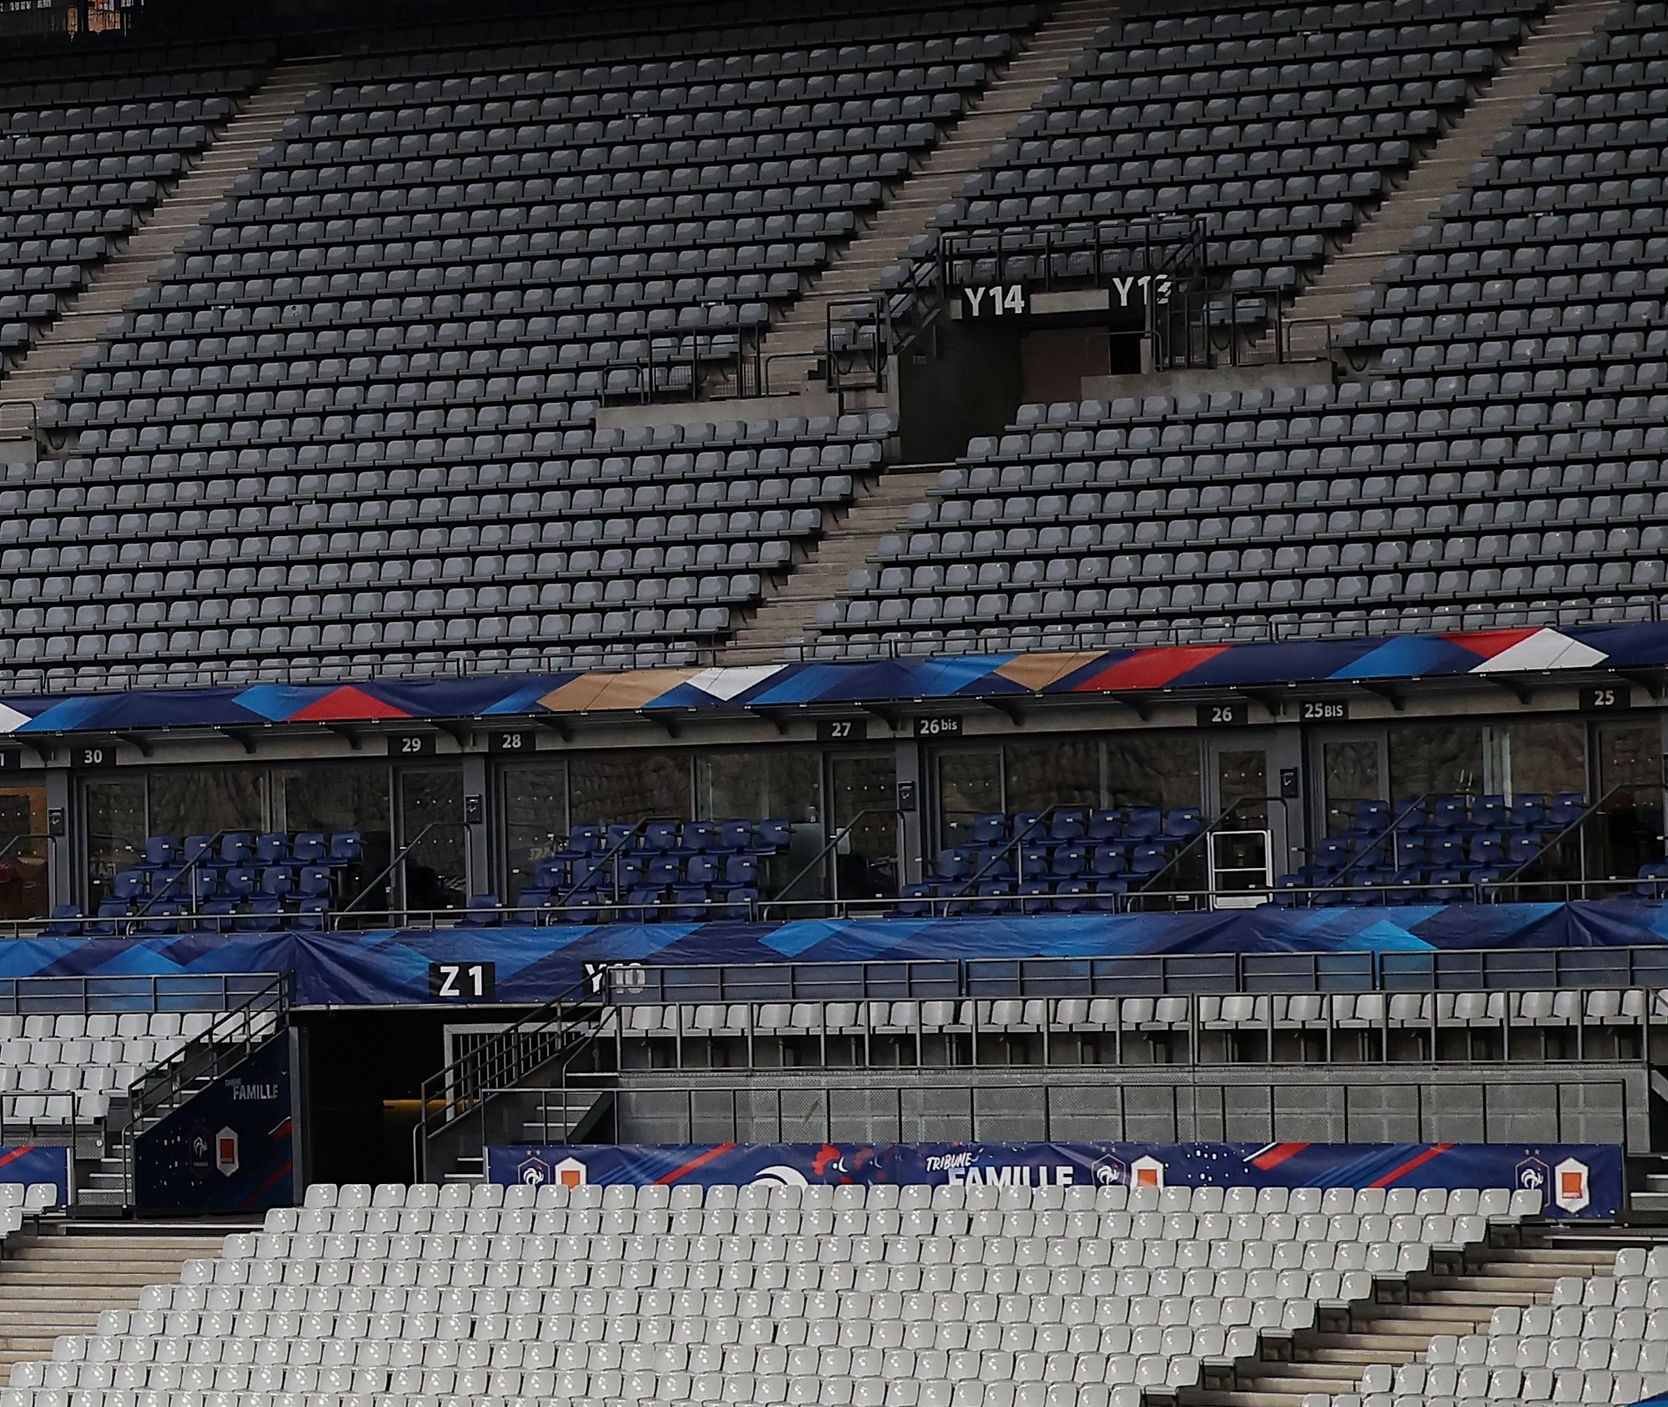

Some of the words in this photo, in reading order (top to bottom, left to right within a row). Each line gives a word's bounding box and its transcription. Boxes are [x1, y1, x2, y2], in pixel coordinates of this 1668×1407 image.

[964, 284, 1025, 317] Y14
[1594, 691, 1614, 706] 25
[1211, 708, 1233, 722] 26
[831, 722, 851, 737] 27
[920, 719, 940, 734] 26
[402, 738, 421, 752] 29
[502, 734, 522, 749] 28
[84, 750, 103, 764] 30
[233, 1084, 279, 1100] FAMILLE
[926, 1152, 973, 1172] TRIBUNE
